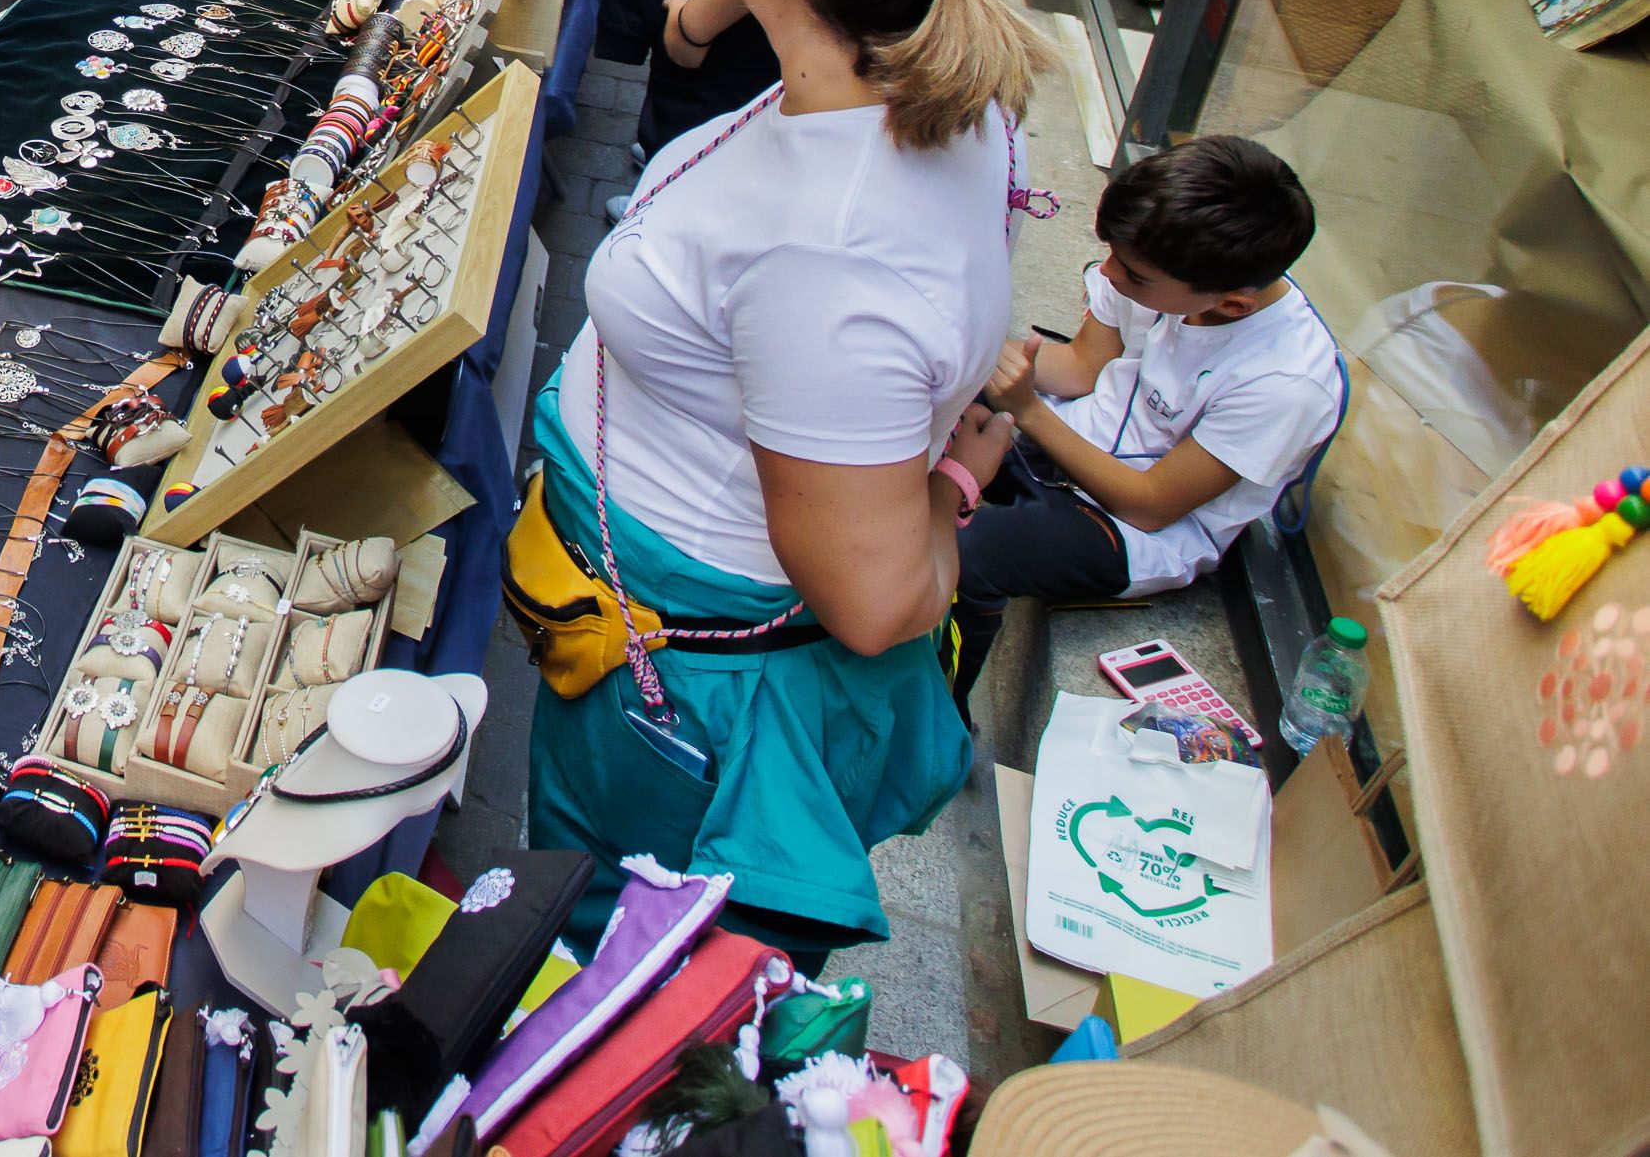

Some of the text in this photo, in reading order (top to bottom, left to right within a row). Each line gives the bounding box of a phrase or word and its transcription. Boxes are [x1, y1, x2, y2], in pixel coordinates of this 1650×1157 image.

[1055, 798, 1076, 841] REDUCE
[1140, 850, 1164, 864] BOLSA
[1139, 858, 1181, 883] 70%
[1140, 872, 1181, 891] RECICLADA
[1155, 910, 1210, 928] RECICLA
